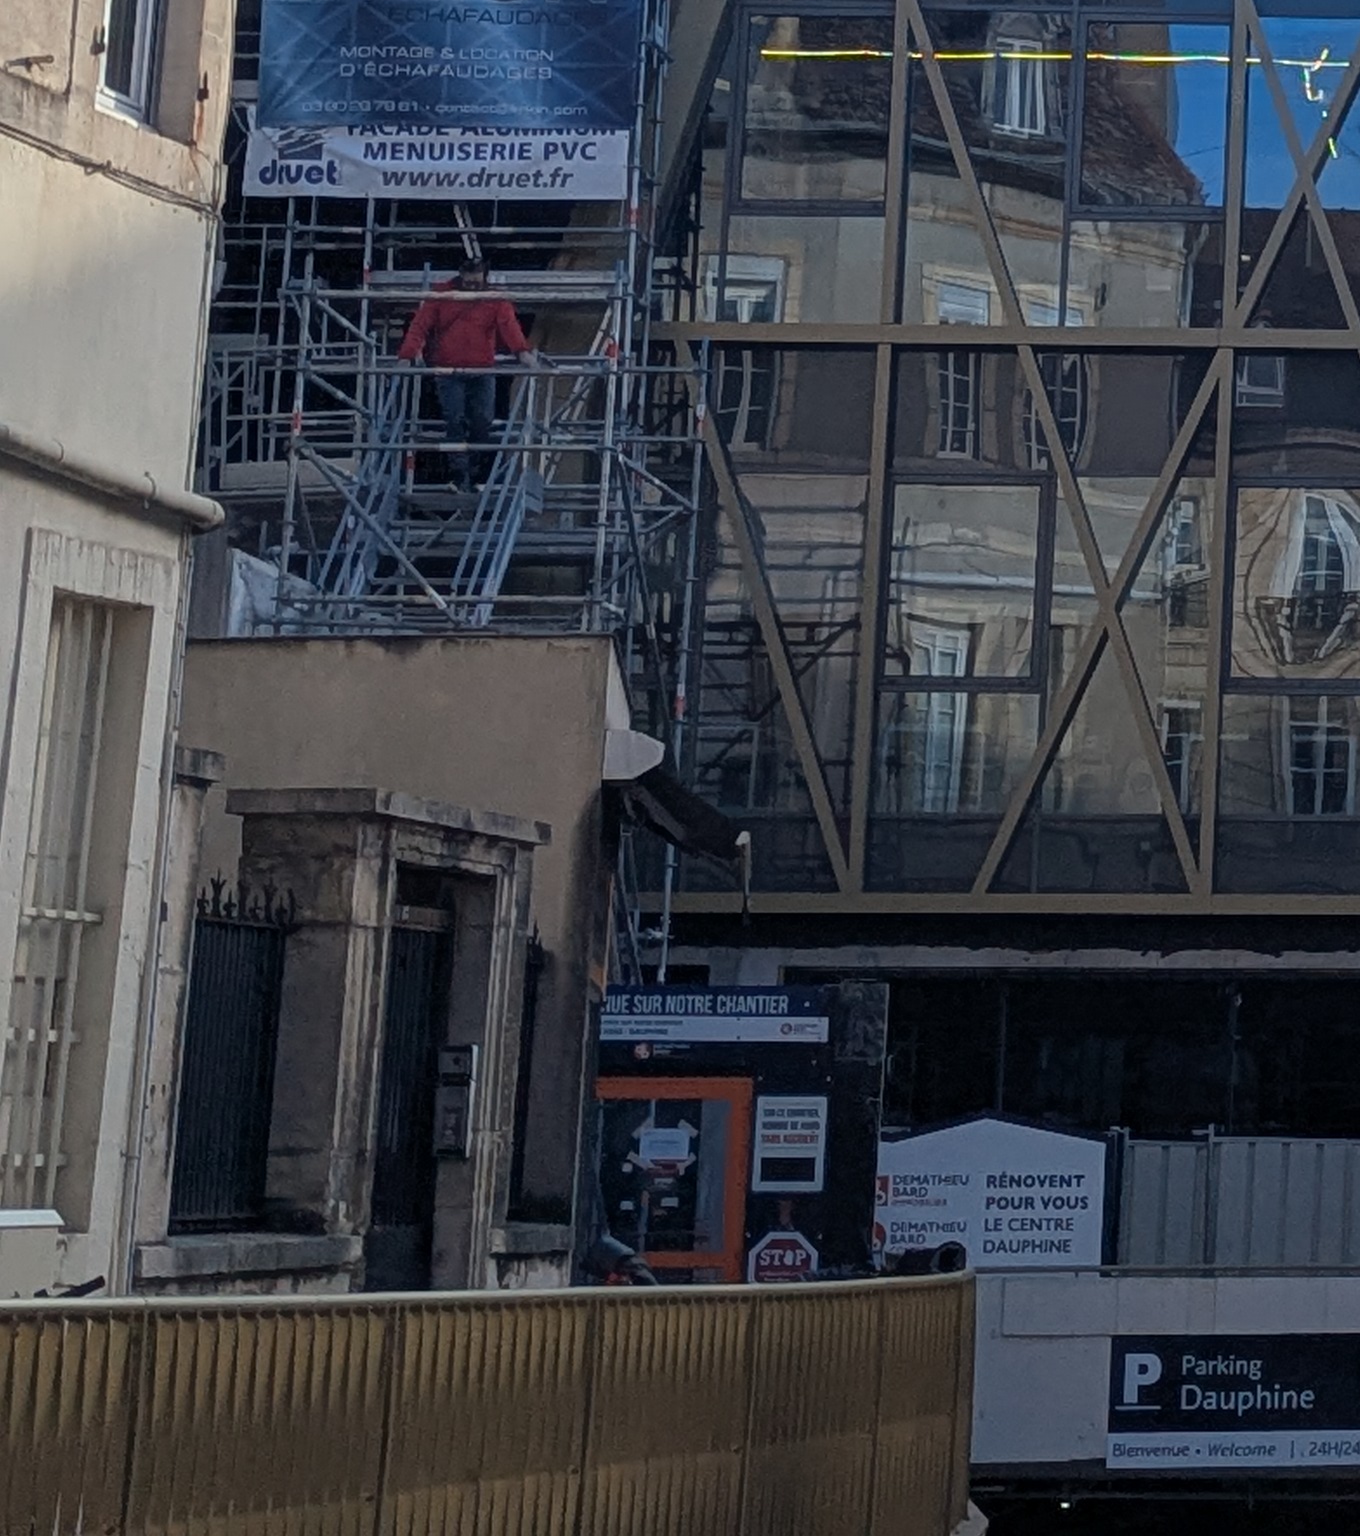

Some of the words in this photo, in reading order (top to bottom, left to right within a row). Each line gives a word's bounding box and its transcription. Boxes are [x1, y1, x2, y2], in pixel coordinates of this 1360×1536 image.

[340, 46, 434, 59] MONTAGE
[441, 47, 454, 59] &
[459, 48, 554, 62] LOCATION
[363, 141, 532, 161] MENUISERIE
[543, 142, 597, 161] PVC
[259, 160, 336, 186] druet
[382, 168, 573, 189] www.druet.fr
[632, 994, 662, 1013] SUR
[665, 994, 712, 1013] NOTRE
[716, 994, 789, 1013] CHANTIER
[893, 1175, 969, 1186] DEMATHIEU
[986, 1172, 1086, 1189] RÉNOVENT
[893, 1187, 928, 1197] BARD
[985, 1197, 1034, 1210] POUR
[1041, 1197, 1090, 1211] VOUS
[891, 1222, 967, 1233] DEMATHIEU
[984, 1218, 1004, 1232] LE
[1008, 1218, 1075, 1232] CENTRE
[890, 1234, 926, 1244] BARD
[983, 1239, 1073, 1254] DAUPHINE
[1181, 1355, 1262, 1380] Parking
[1123, 1353, 1163, 1404] P
[1181, 1384, 1315, 1416] Dauphine
[1112, 1443, 1189, 1457] Bienvenue
[1208, 1442, 1276, 1457] Welcome
[1309, 1441, 1360, 1456] 24H/24
